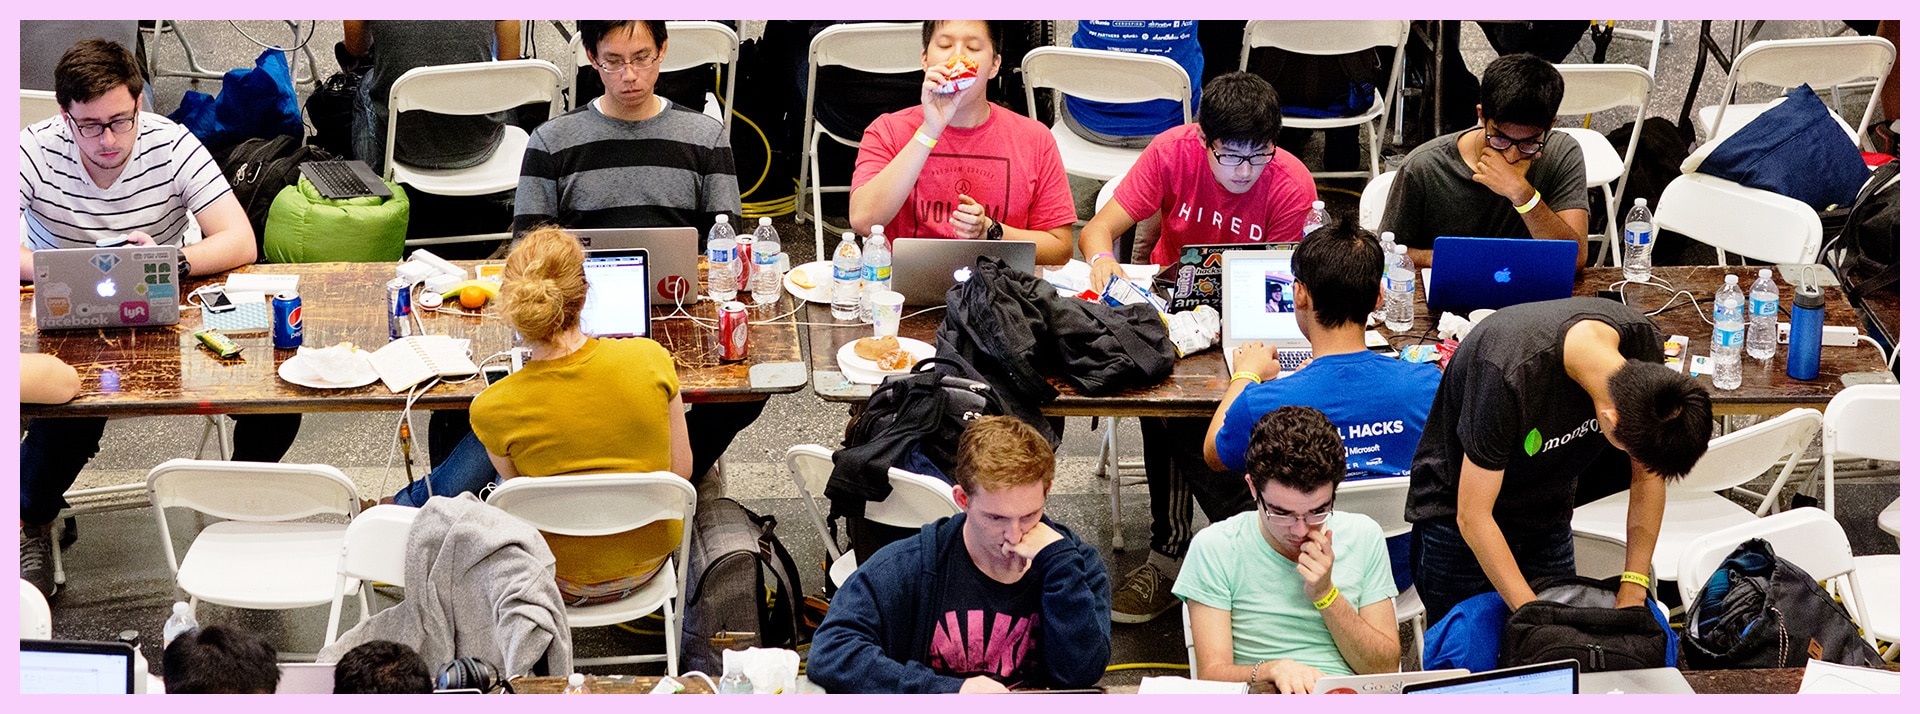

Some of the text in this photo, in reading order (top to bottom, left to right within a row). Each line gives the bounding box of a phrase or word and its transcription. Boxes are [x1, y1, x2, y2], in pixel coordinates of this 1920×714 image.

[921, 200, 1000, 224] VOLM
[1178, 203, 1263, 241] HIRED
[1196, 266, 1222, 275] hacks
[1176, 265, 1195, 298] twitch
[1175, 298, 1222, 307] amaz
[123, 306, 146, 319] lyft
[40, 314, 110, 327] facebook
[1348, 420, 1404, 439] HACKS
[1541, 418, 1603, 453] mongo
[1349, 444, 1381, 455] Microsoft
[1345, 462, 1359, 470] ER
[929, 609, 1040, 678] NIKE
[1361, 681, 1403, 692] Googl
